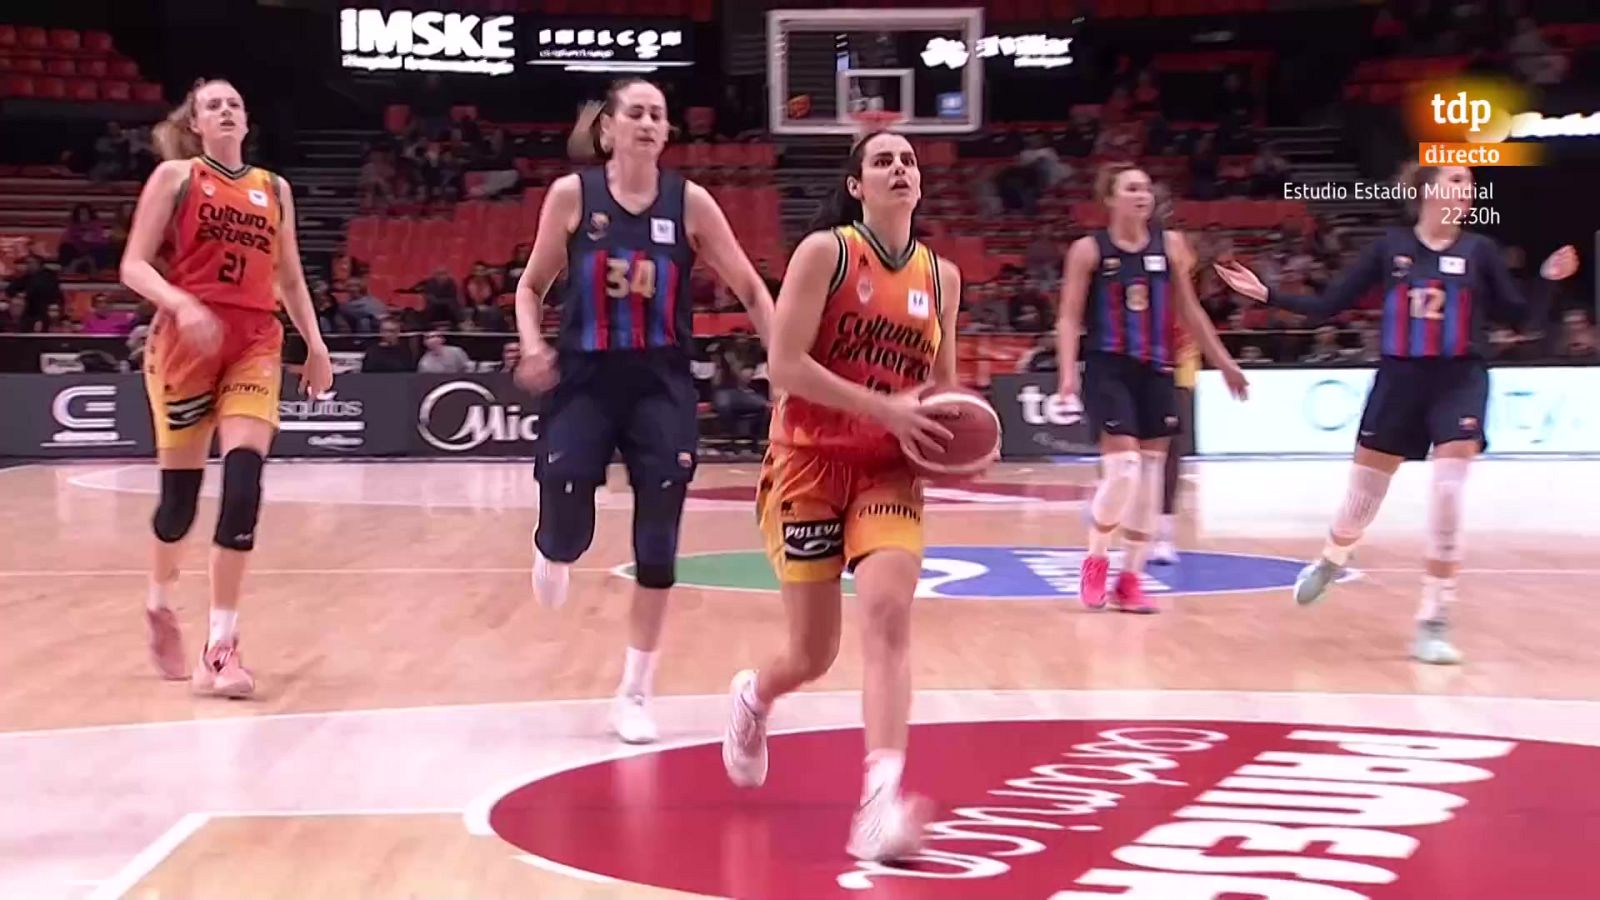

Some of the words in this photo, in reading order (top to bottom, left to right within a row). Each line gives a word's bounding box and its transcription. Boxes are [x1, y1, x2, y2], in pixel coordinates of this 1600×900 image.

[340, 8, 515, 58] IMSKE
[196, 221, 271, 254] Esfuerz
[218, 251, 246, 286] 21
[606, 257, 656, 299] 34
[1408, 287, 1447, 320] 12
